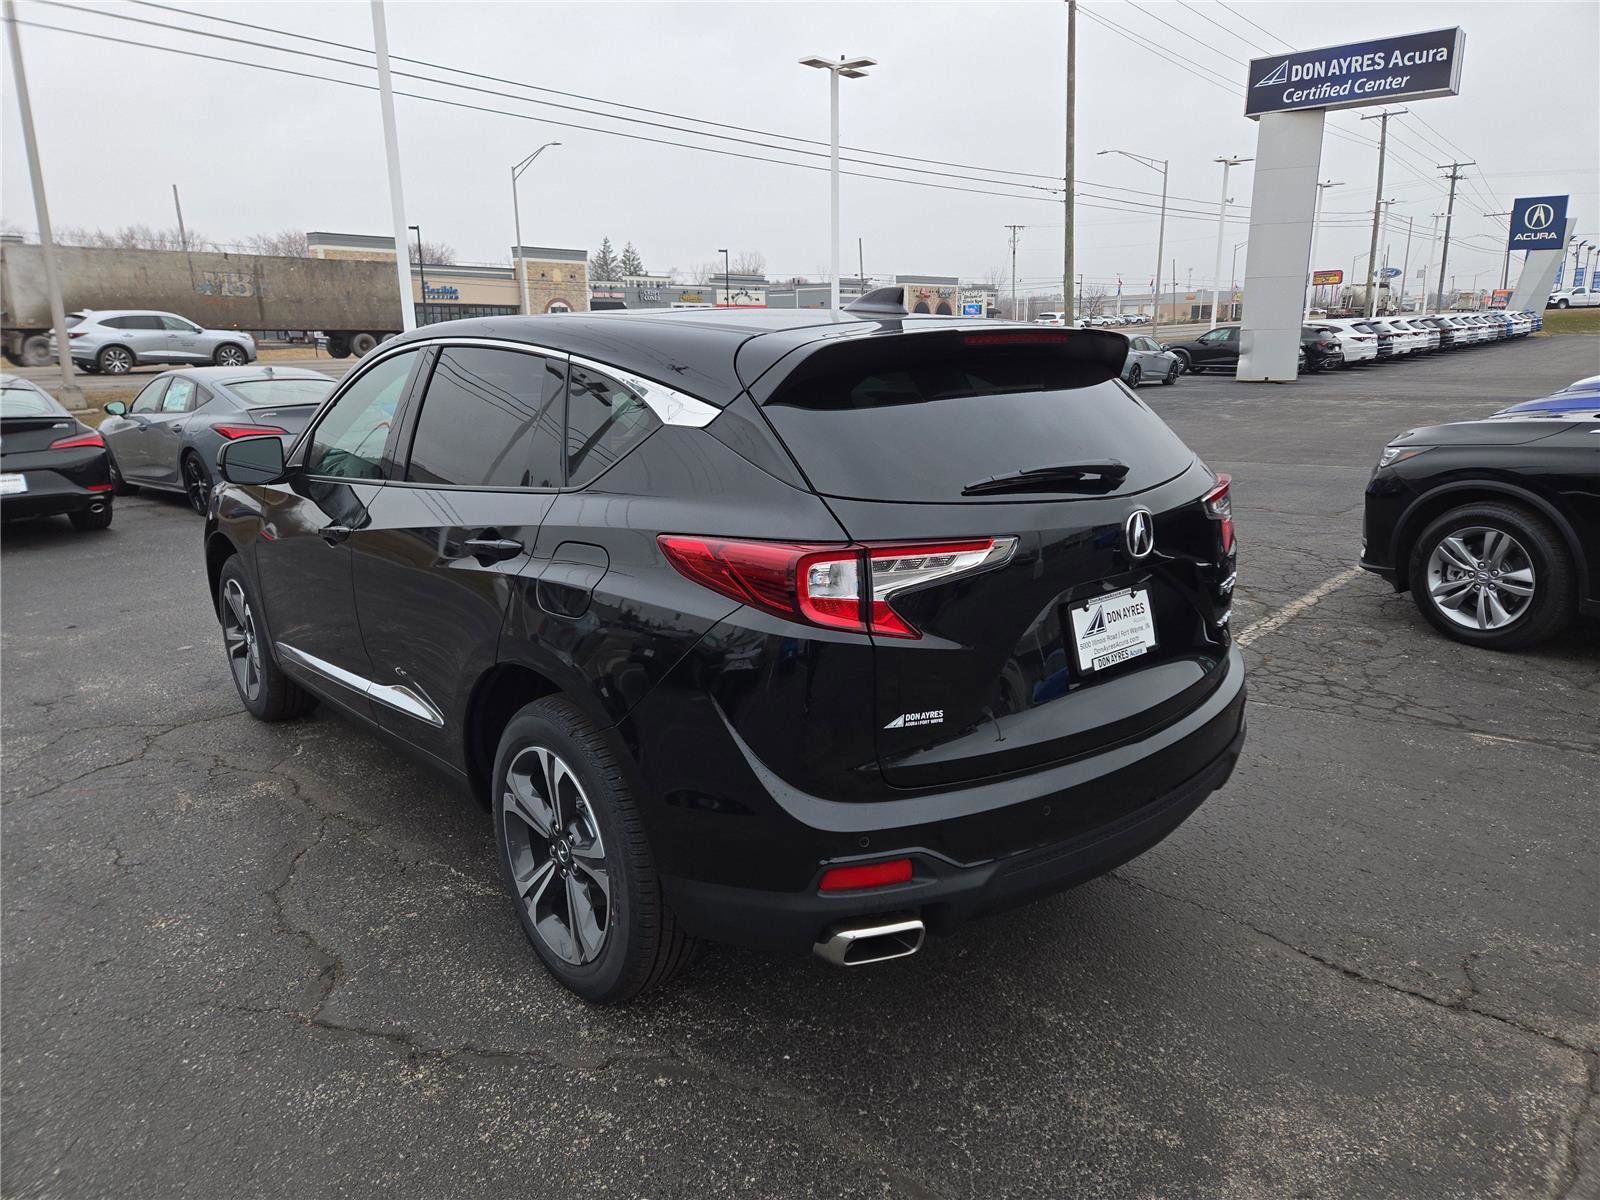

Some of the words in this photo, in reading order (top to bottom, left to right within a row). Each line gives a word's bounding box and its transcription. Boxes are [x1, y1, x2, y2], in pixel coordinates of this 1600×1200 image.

[1291, 61, 1326, 82] DON
[1328, 52, 1385, 76] AYRES
[1388, 47, 1448, 68] Acura
[1283, 80, 1350, 103] Certified
[1354, 74, 1410, 96] Center
[1514, 232, 1557, 241] ACURA
[1107, 610, 1122, 624] DON
[1122, 602, 1145, 619] AYRES
[1098, 657, 1111, 668] DON
[1111, 649, 1130, 662] AYRES
[1130, 648, 1143, 657] Acura
[905, 713, 920, 721] DON
[920, 710, 944, 720] AYRES
